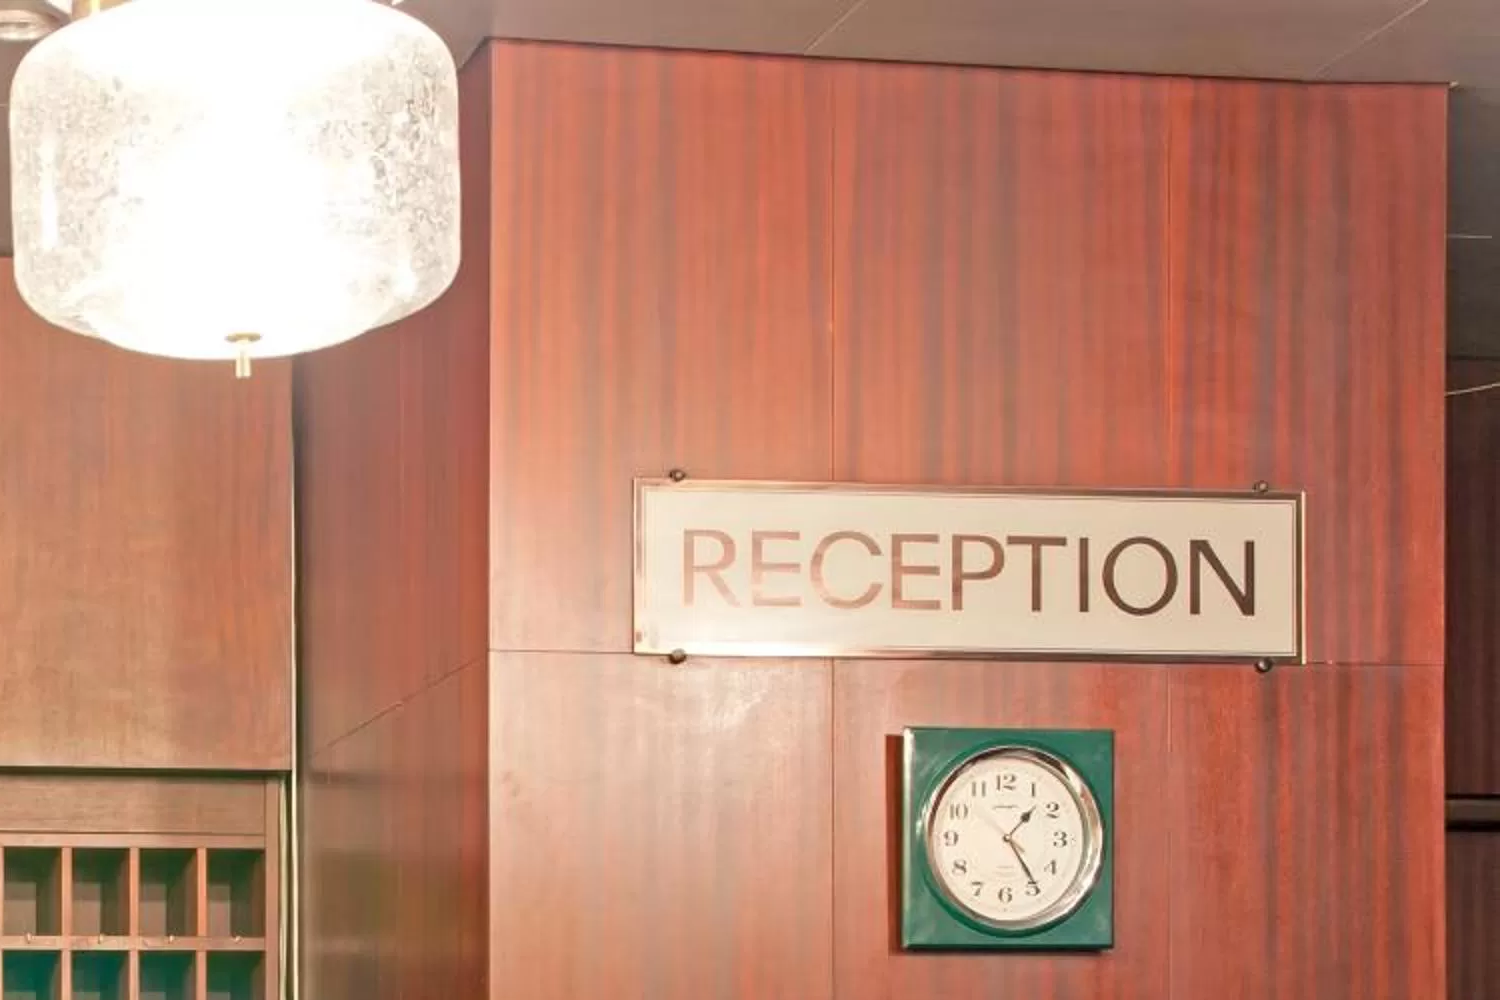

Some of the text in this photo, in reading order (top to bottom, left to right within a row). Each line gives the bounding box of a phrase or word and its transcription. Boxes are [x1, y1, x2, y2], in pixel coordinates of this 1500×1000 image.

[683, 529, 1255, 617] RECEPTION
[971, 781, 986, 797] 11
[996, 774, 1017, 791] 12
[1031, 782, 1037, 797] 1
[950, 803, 969, 820] 10
[1045, 801, 1060, 819] 2
[943, 830, 959, 846] 9
[1052, 831, 1067, 847] 3
[952, 860, 967, 875] 8
[1044, 860, 1057, 875] 4
[971, 881, 984, 898] 7
[998, 886, 1013, 903] 6
[1025, 880, 1041, 897] 5
